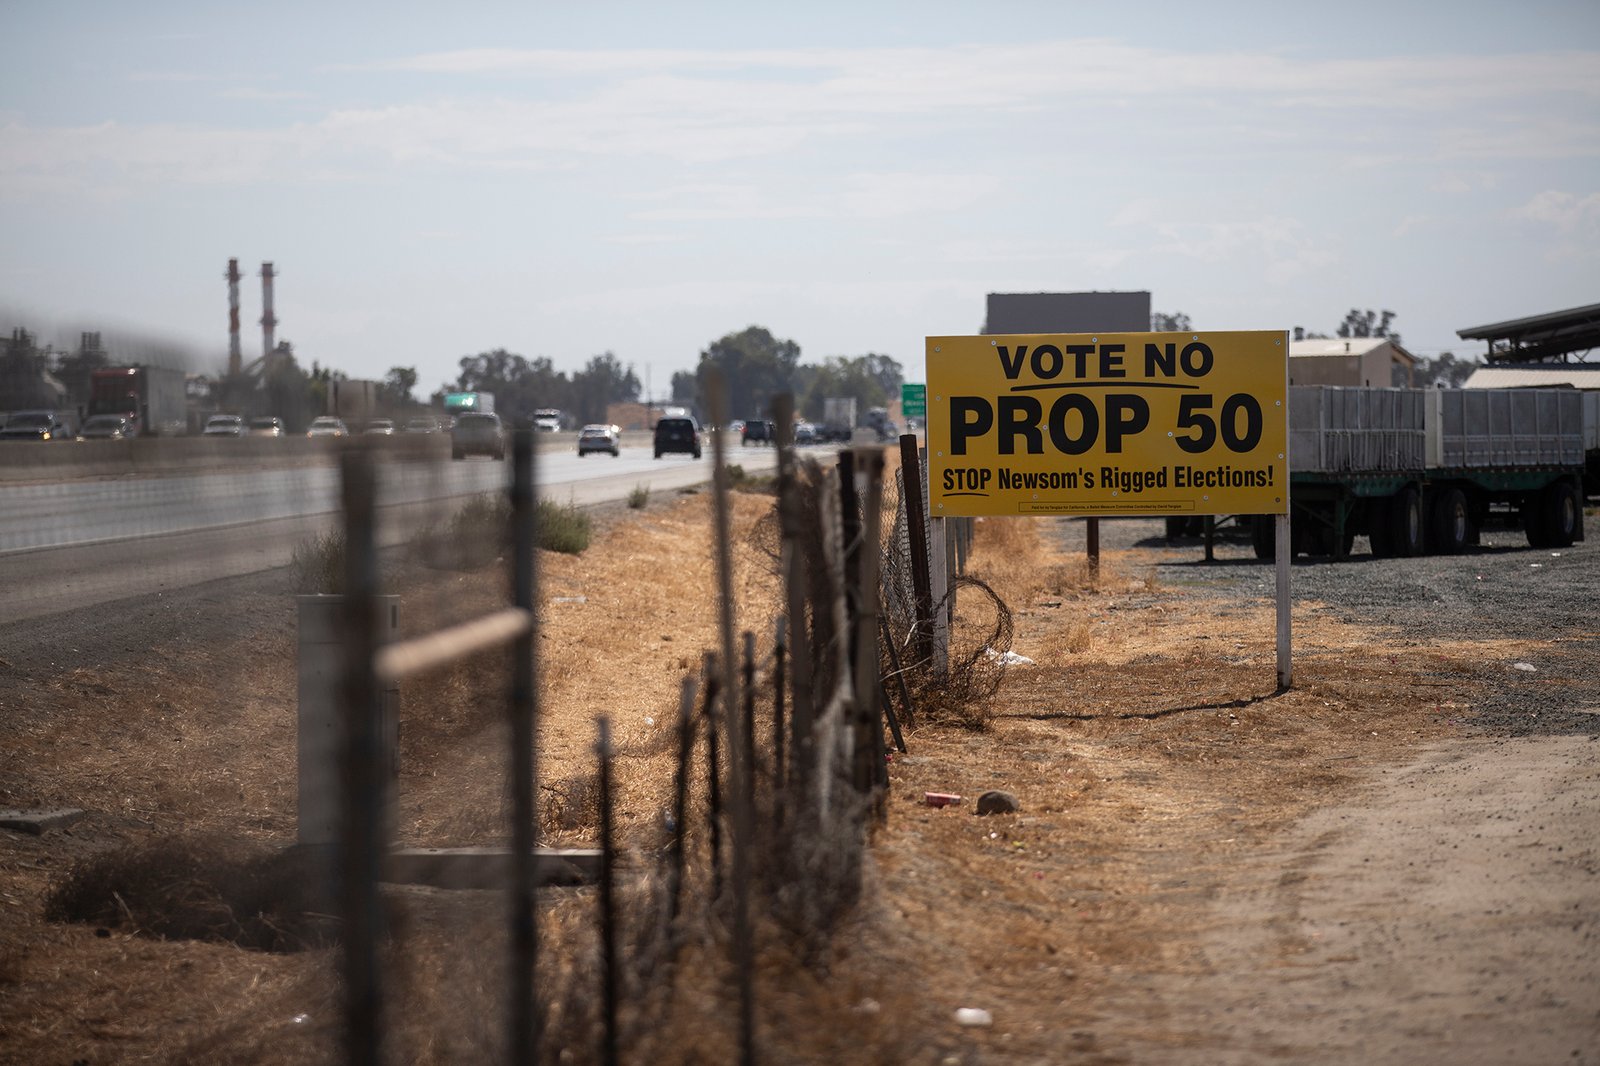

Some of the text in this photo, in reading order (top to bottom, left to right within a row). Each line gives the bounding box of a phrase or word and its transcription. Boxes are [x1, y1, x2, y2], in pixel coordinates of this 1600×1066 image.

[997, 341, 1214, 380] VOTE NO
[949, 393, 1150, 456] PROP
[1174, 392, 1263, 454] 50
[943, 464, 1274, 494] STOP Newsom's Rigged Elections!
